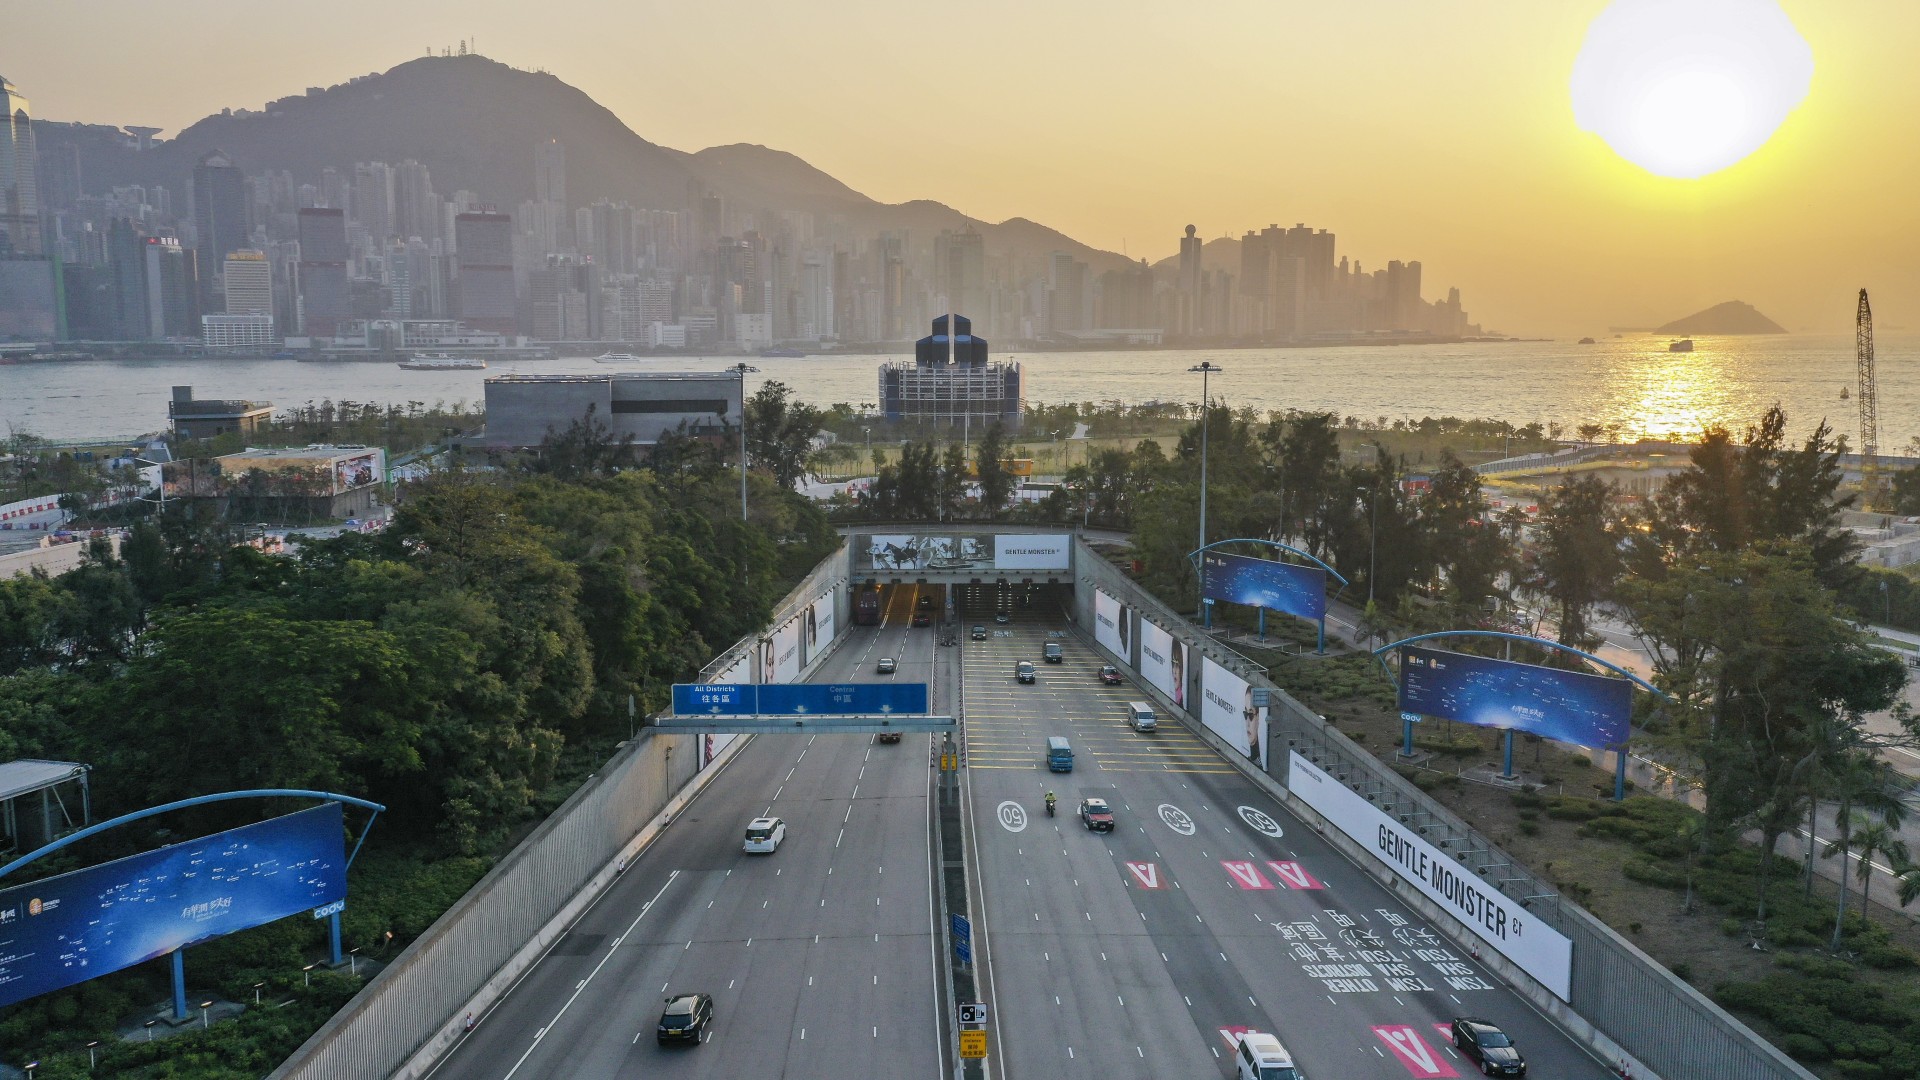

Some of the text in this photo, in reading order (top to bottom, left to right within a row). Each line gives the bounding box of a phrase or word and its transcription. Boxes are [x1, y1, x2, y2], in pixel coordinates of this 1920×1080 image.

[702, 694, 730, 703] 往各區
[834, 694, 852, 703] 中區
[1206, 688, 1217, 705] GENTLE
[1401, 713, 1422, 722] cody
[1004, 808, 1022, 824] 50
[1246, 812, 1277, 830] 50
[1378, 824, 1506, 941] GENTLE MONSTER
[314, 900, 344, 918] cody
[1356, 950, 1403, 963] TSUI
[1411, 950, 1459, 962] TSUI
[1302, 964, 1372, 978] DISTRICTS
[1373, 963, 1416, 977] SHA
[1431, 962, 1474, 976] SHA
[1322, 978, 1379, 993] OTHER
[1384, 978, 1434, 992] TSIM
[1444, 977, 1495, 990] TSIM
